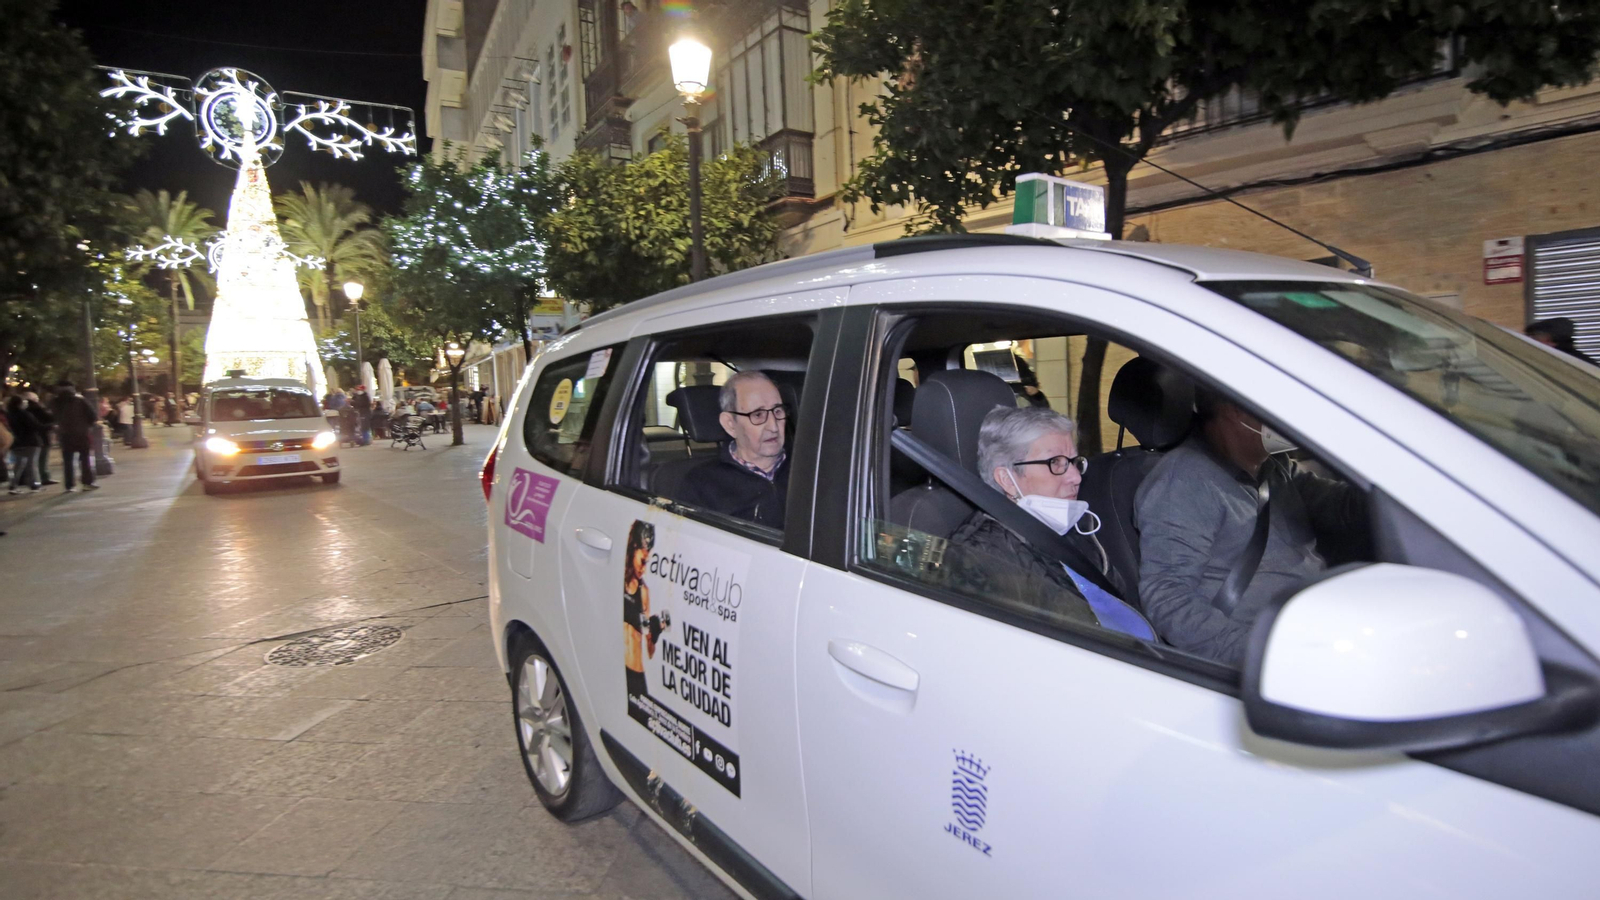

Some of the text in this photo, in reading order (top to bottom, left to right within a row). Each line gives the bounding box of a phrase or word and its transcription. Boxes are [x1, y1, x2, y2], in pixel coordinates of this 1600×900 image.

[1066, 195, 1103, 221] TA
[650, 553, 742, 608] activaclub
[662, 639, 731, 700] MEJOR DE
[683, 621, 731, 669] VEN AL
[662, 665, 678, 695] LA
[681, 677, 731, 728] CIUDAD
[944, 822, 992, 857] JEREZ
